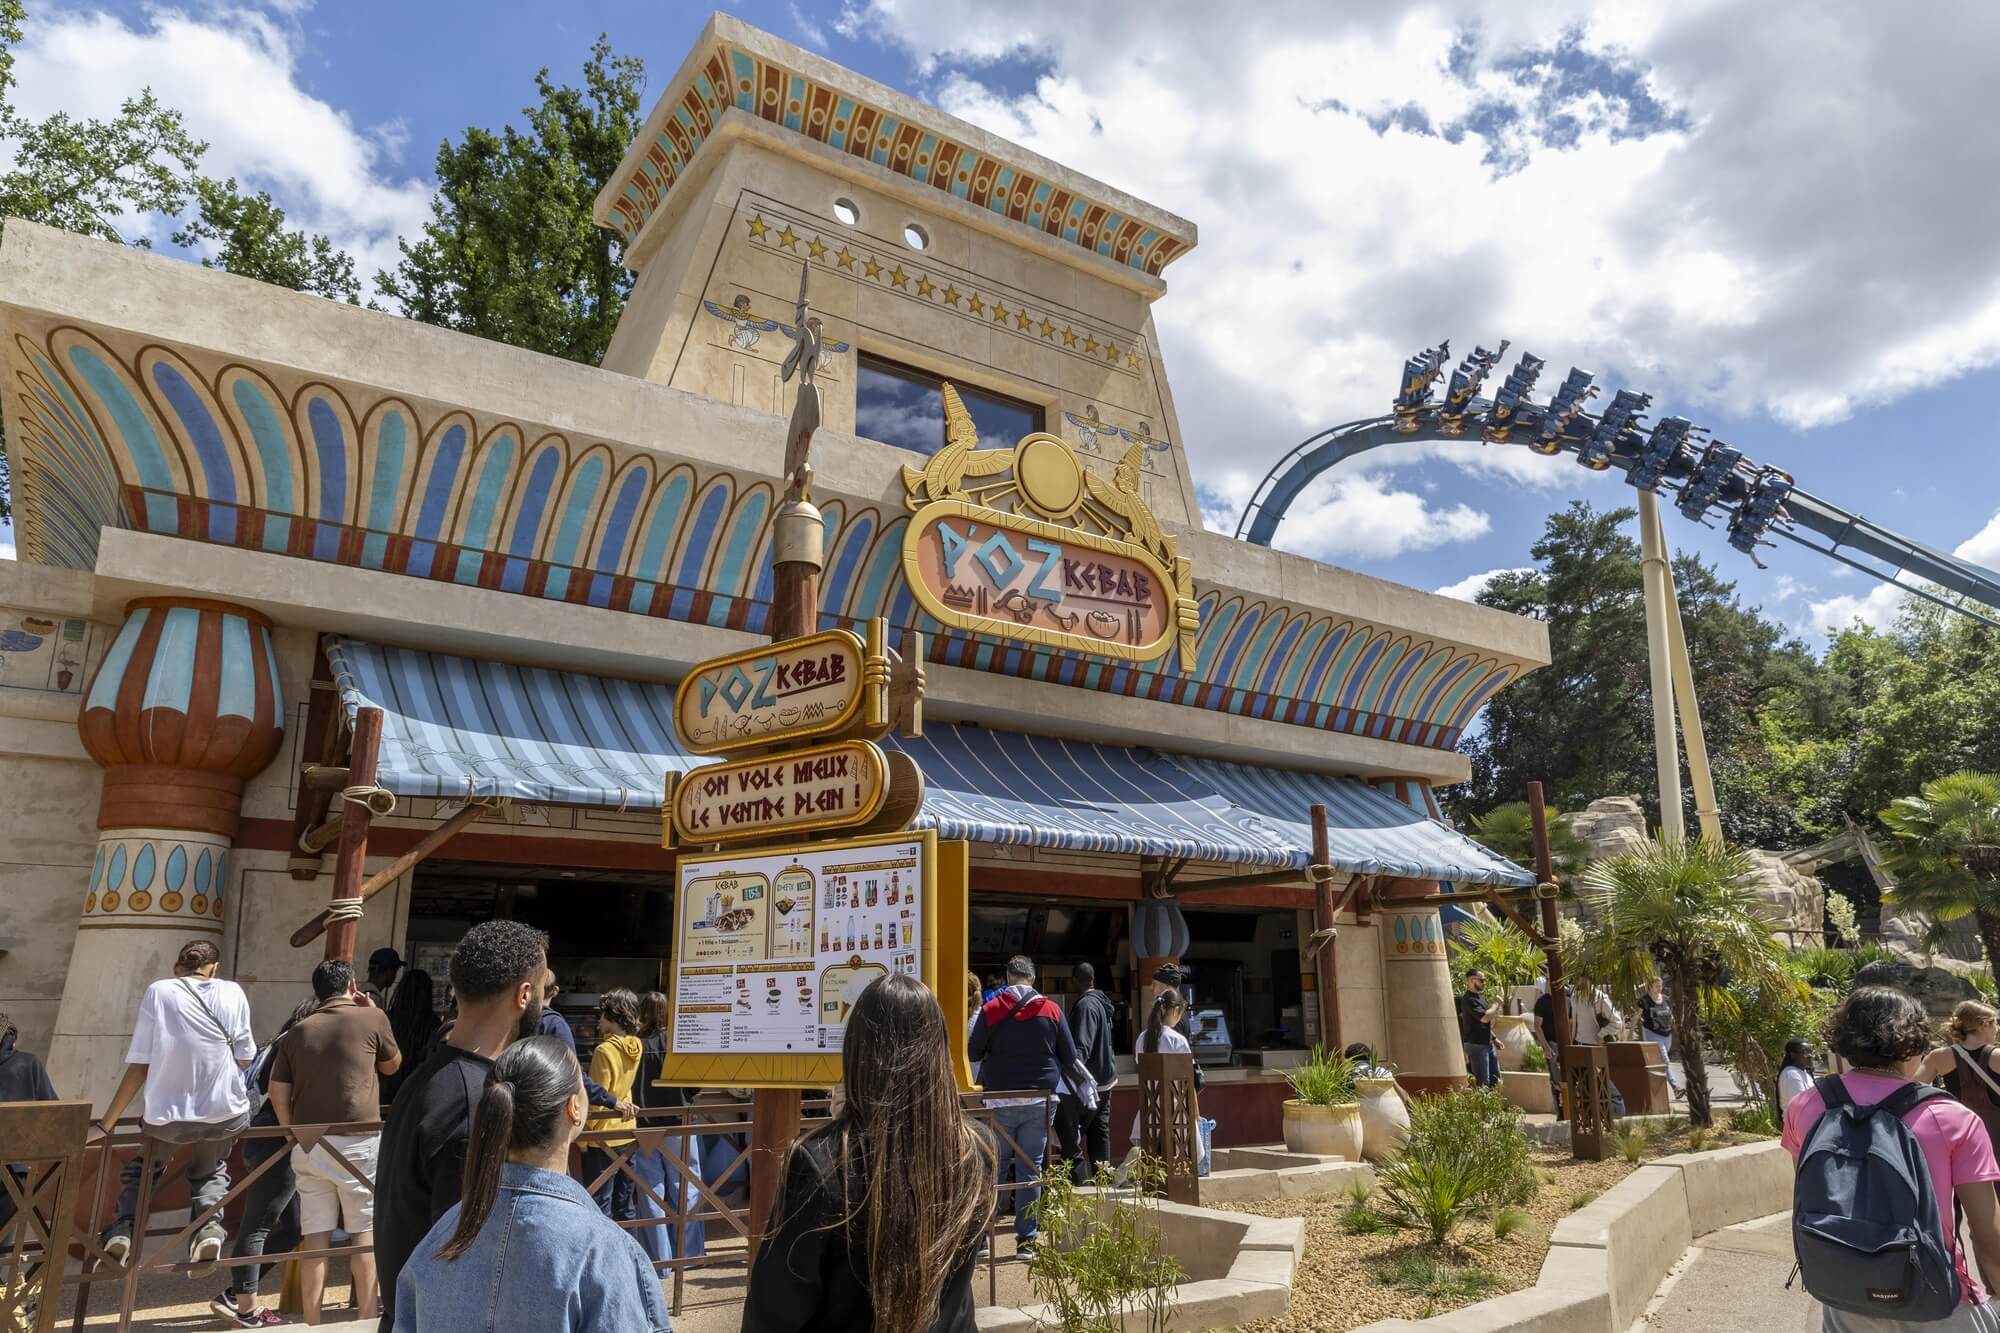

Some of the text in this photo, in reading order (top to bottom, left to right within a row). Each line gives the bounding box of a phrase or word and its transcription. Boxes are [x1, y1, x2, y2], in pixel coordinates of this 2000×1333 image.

[938, 521, 1152, 602] P'OZ KEBAB
[699, 654, 846, 719] P'OZ KEBAB
[703, 755, 848, 797] ON VOLE MIEUX
[690, 784, 861, 830] LE VENTRE PLEIN !
[715, 880, 739, 891] KEBAB
